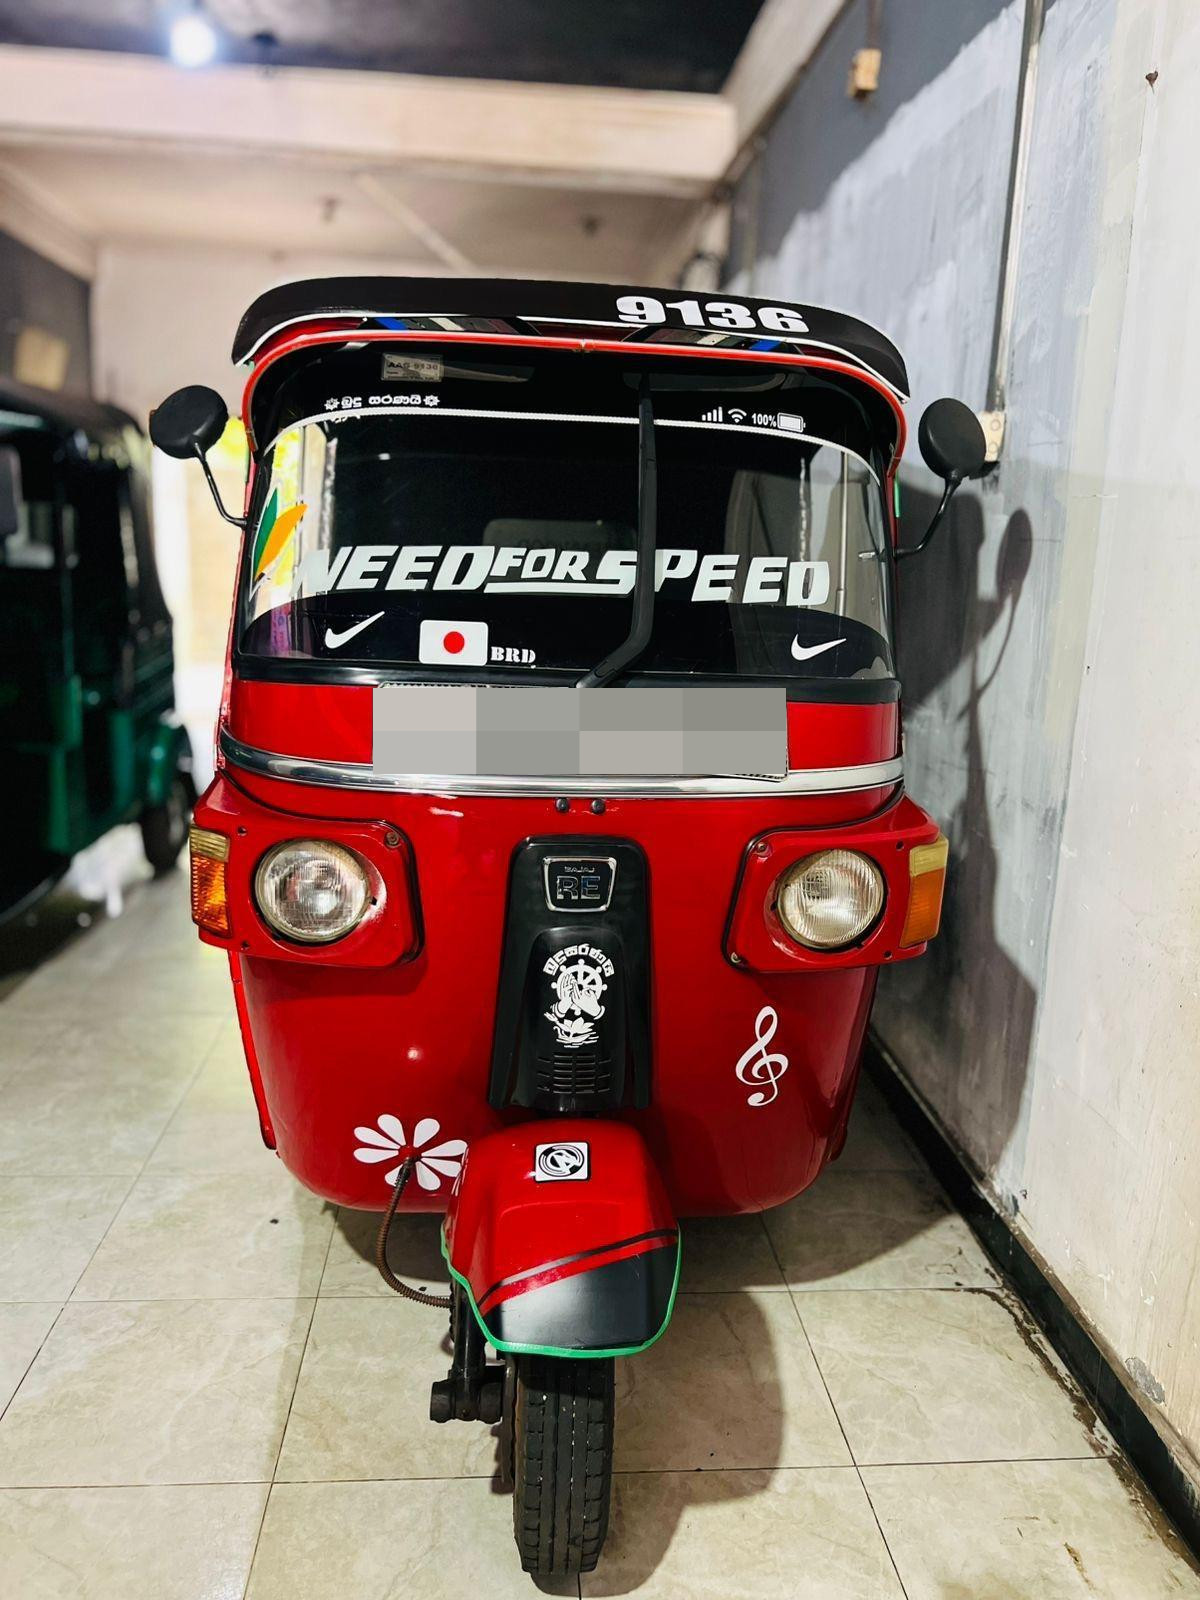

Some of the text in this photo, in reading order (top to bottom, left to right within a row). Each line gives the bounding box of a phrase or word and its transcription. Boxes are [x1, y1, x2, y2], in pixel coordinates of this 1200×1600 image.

[616, 295, 810, 333] 9136
[368, 394, 422, 405] සරණයි
[751, 412, 777, 428] 100%
[290, 545, 831, 607] NEED FOR SPEED
[490, 646, 536, 664] BRD
[556, 875, 600, 900] RE
